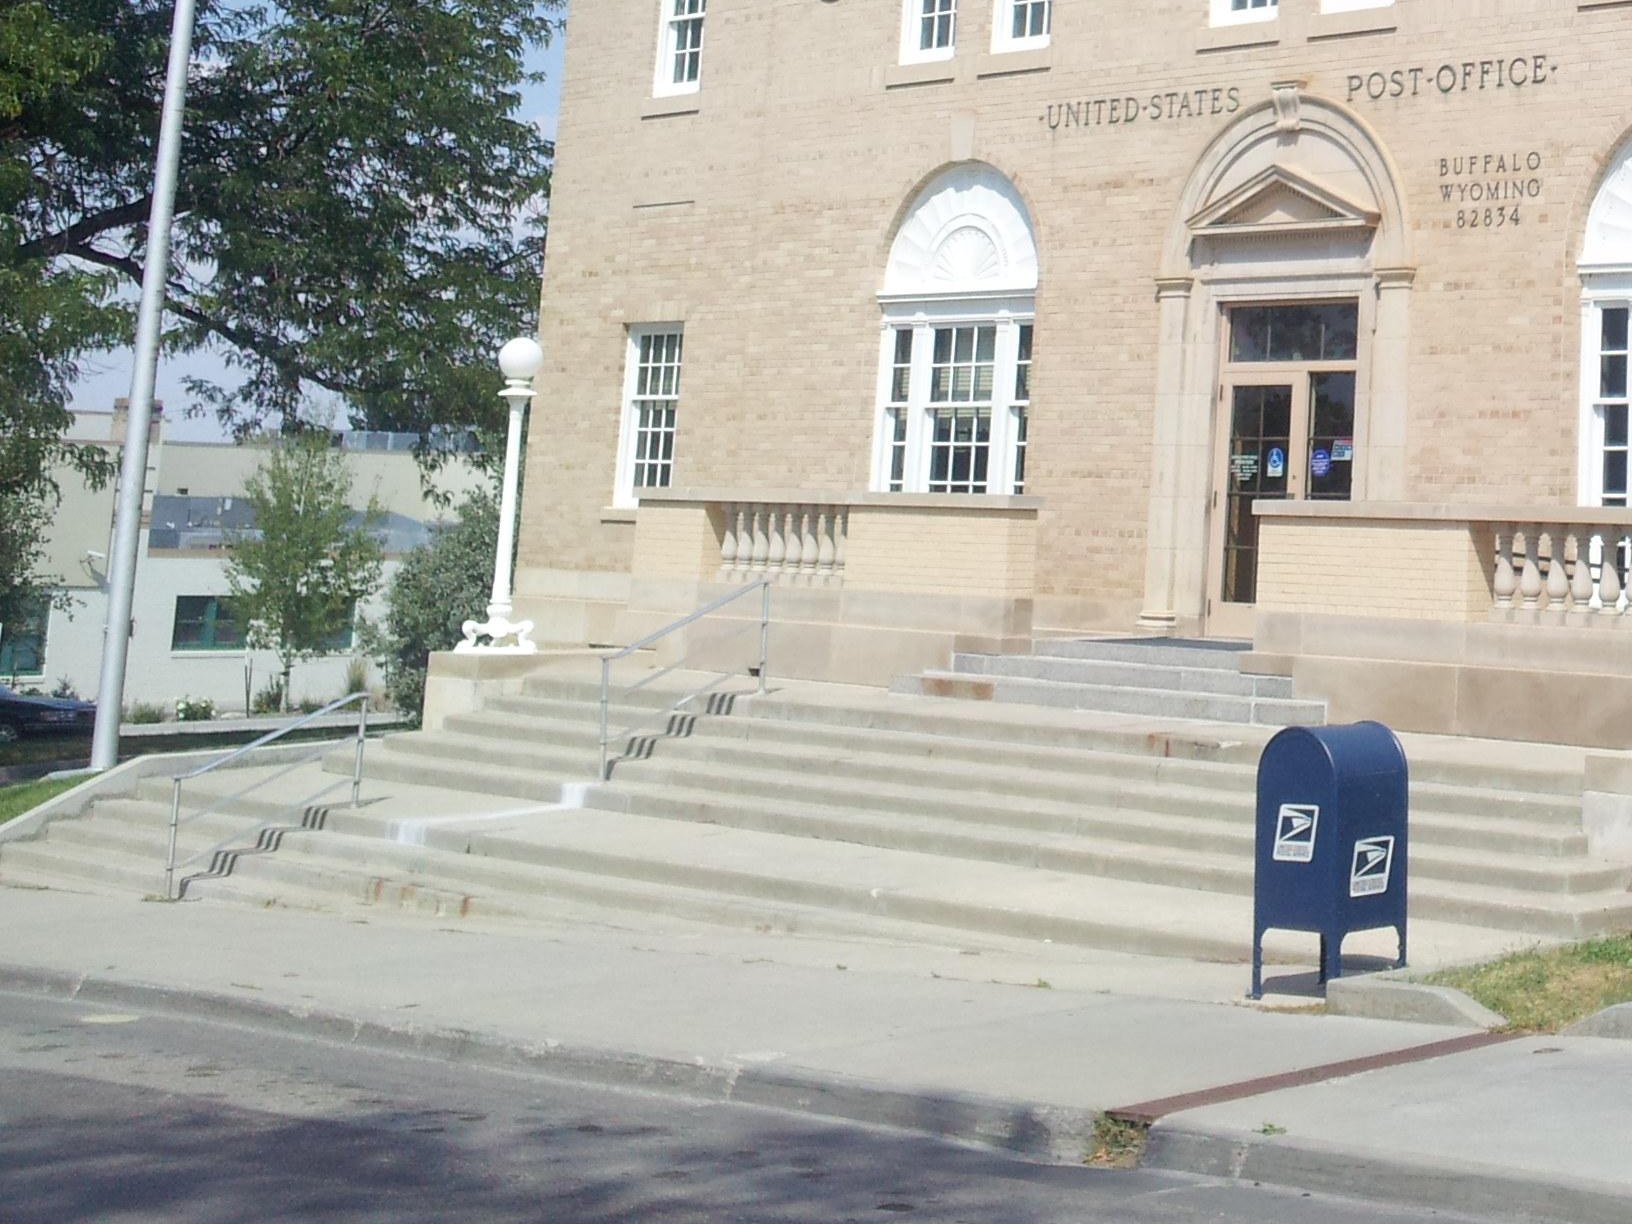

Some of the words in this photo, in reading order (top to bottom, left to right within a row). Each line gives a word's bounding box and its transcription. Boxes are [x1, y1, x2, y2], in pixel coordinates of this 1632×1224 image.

[1345, 72, 1424, 102] POST
[1436, 55, 1548, 93] OFFICE
[1046, 102, 1140, 130] UNITED
[1150, 87, 1241, 118] STATES
[1438, 151, 1541, 177] BUFFALO
[1439, 178, 1540, 202] WYOMING
[1456, 205, 1521, 228] 82834
